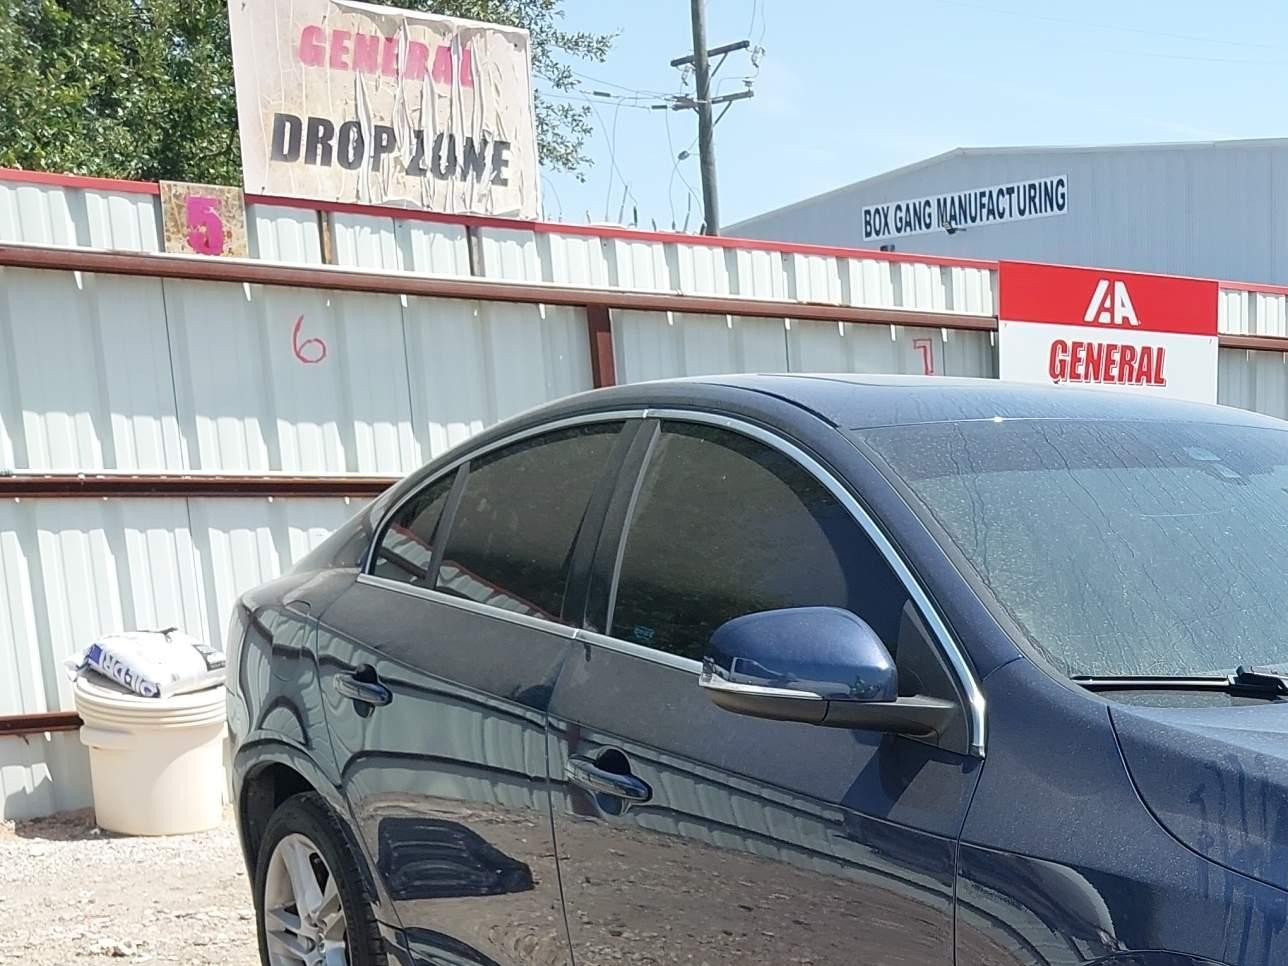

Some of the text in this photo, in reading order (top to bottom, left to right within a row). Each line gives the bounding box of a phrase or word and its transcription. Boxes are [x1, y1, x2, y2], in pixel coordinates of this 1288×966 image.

[298, 24, 475, 89] GENERAL
[270, 112, 512, 187] DROP ZONE
[184, 195, 226, 257] 5
[863, 178, 1067, 239] BOX GANG MANUFACTURING
[292, 314, 327, 364] 6
[1048, 339, 1168, 388] GENERAL
